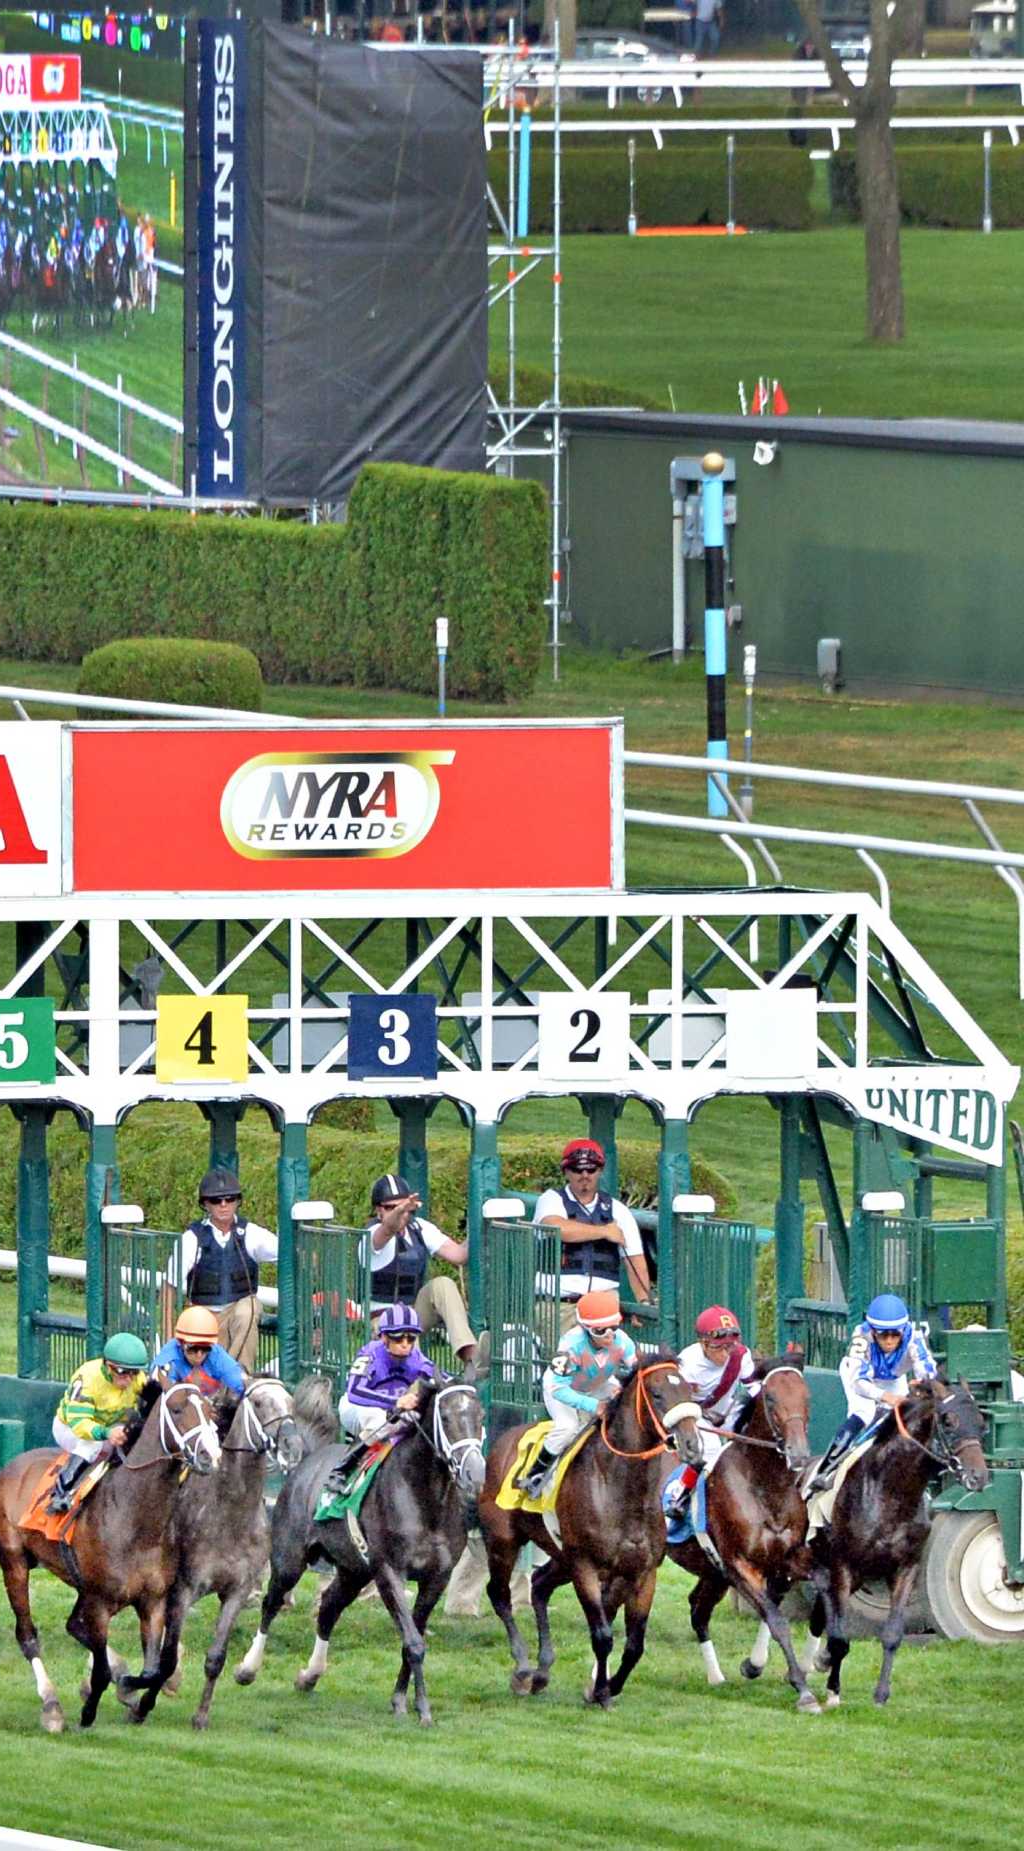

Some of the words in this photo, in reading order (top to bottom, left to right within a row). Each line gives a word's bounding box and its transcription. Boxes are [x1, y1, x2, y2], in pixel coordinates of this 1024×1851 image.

[213, 34, 235, 484] LONGINES
[258, 771, 398, 819] NYRA
[247, 821, 408, 842] REWARDS
[184, 1011, 217, 1065] 4
[377, 1008, 411, 1066] 3
[568, 1009, 601, 1063] 2
[866, 1088, 997, 1151] UNITED
